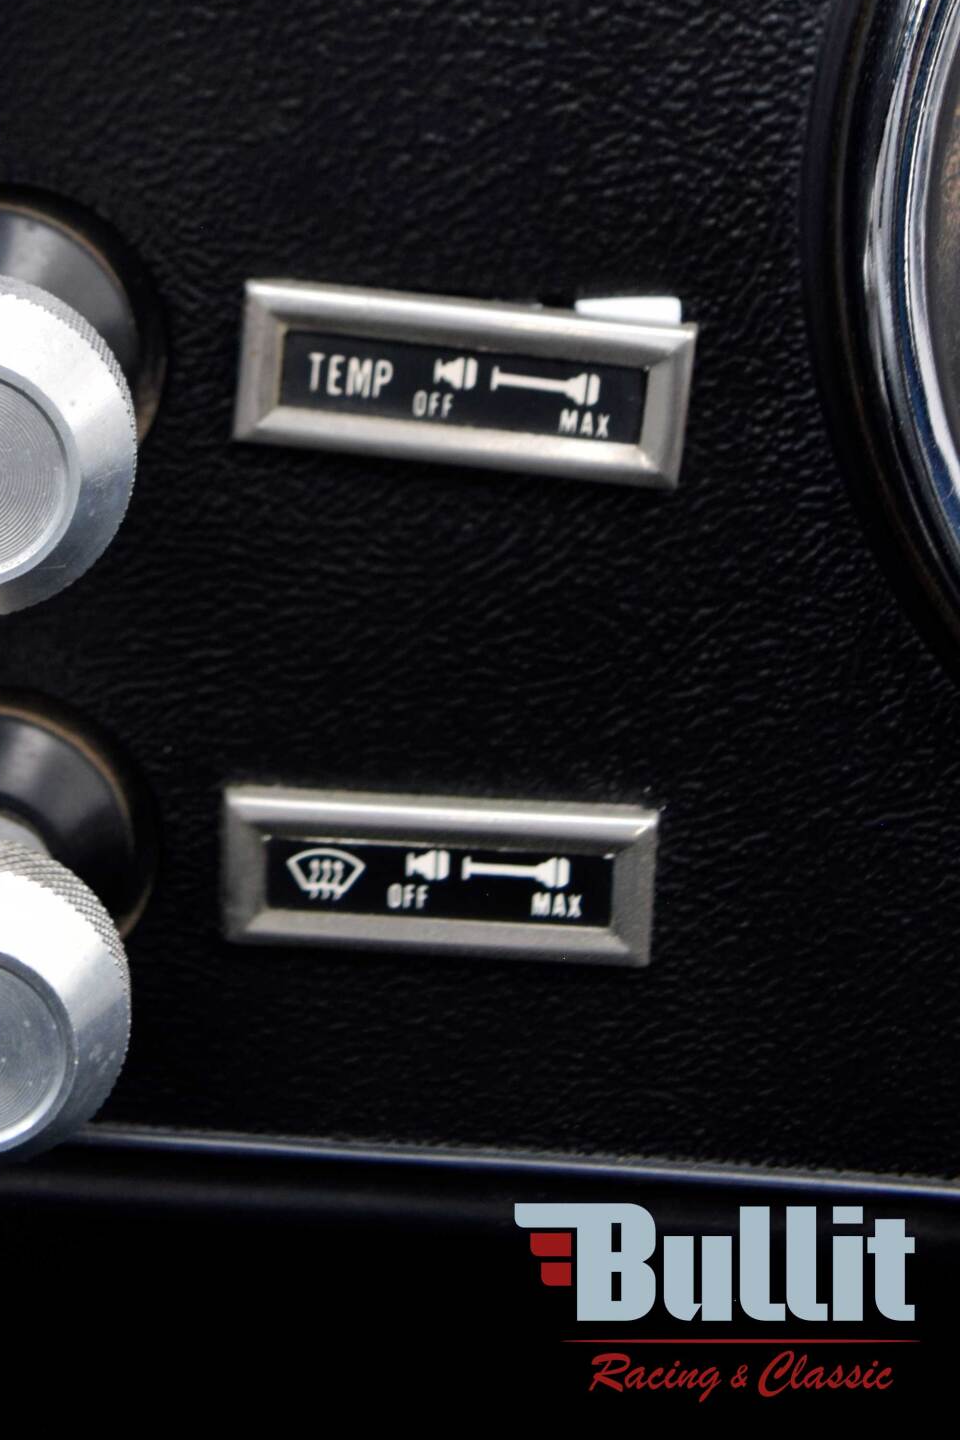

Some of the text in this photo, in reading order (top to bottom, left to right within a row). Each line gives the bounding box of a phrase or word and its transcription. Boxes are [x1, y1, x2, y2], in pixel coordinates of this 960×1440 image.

[308, 352, 394, 399] TEMP
[412, 390, 611, 439] OFF MAX
[386, 883, 583, 919] OFF MAX
